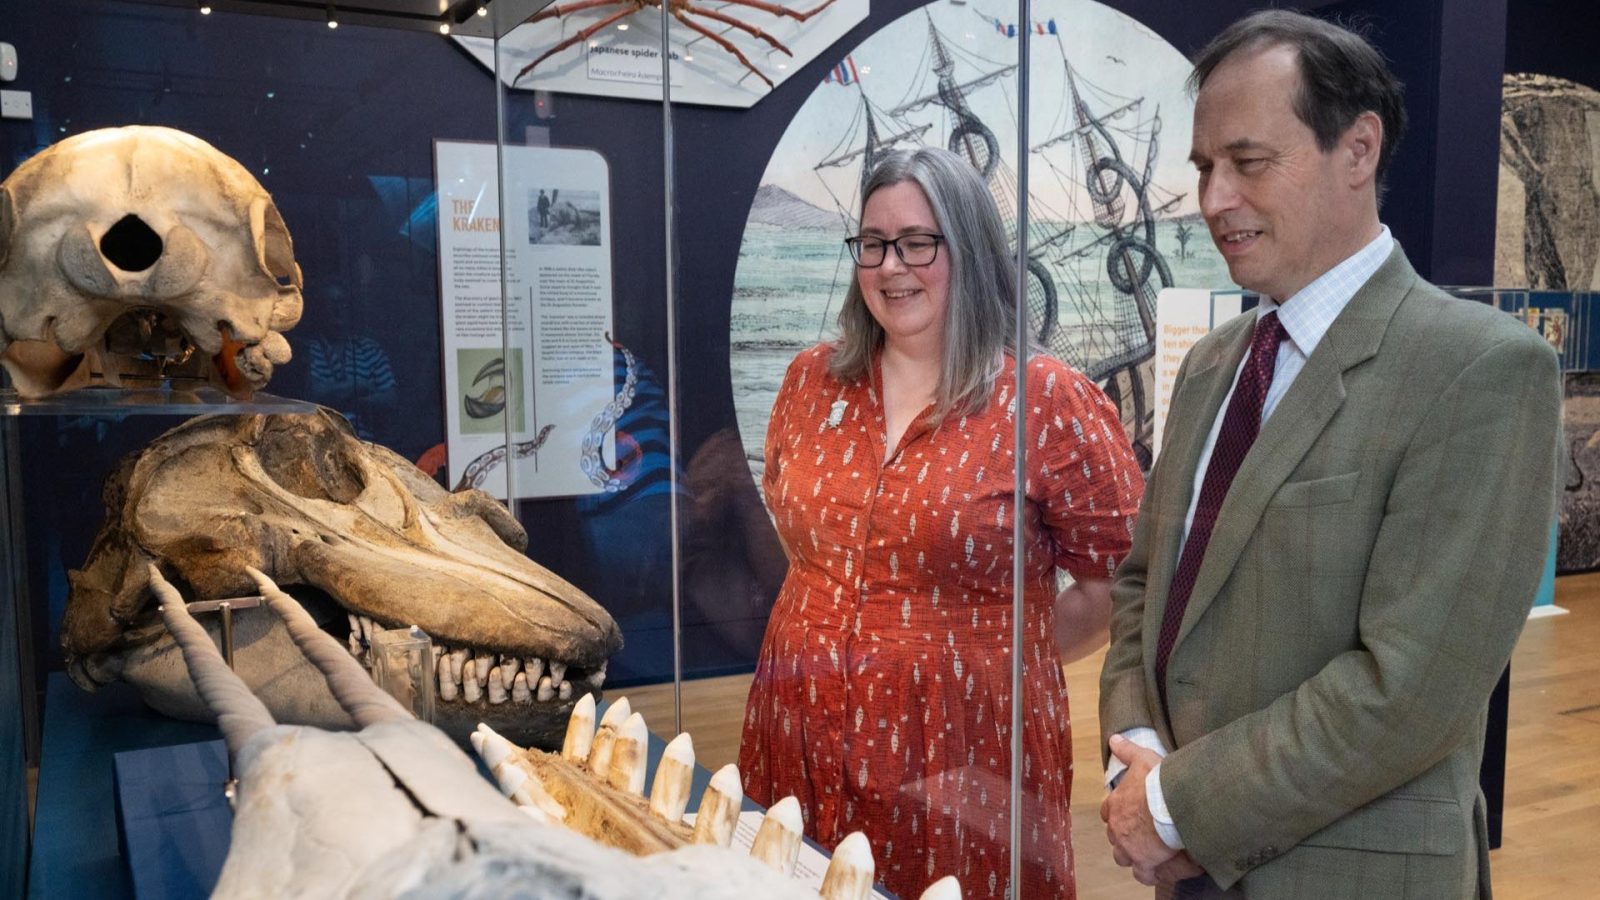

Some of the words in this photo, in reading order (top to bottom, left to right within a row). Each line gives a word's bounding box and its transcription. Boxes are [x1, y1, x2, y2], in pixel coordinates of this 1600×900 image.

[631, 48, 658, 58] spider
[661, 50, 679, 60] ab
[1163, 324, 1190, 336] Bigger
